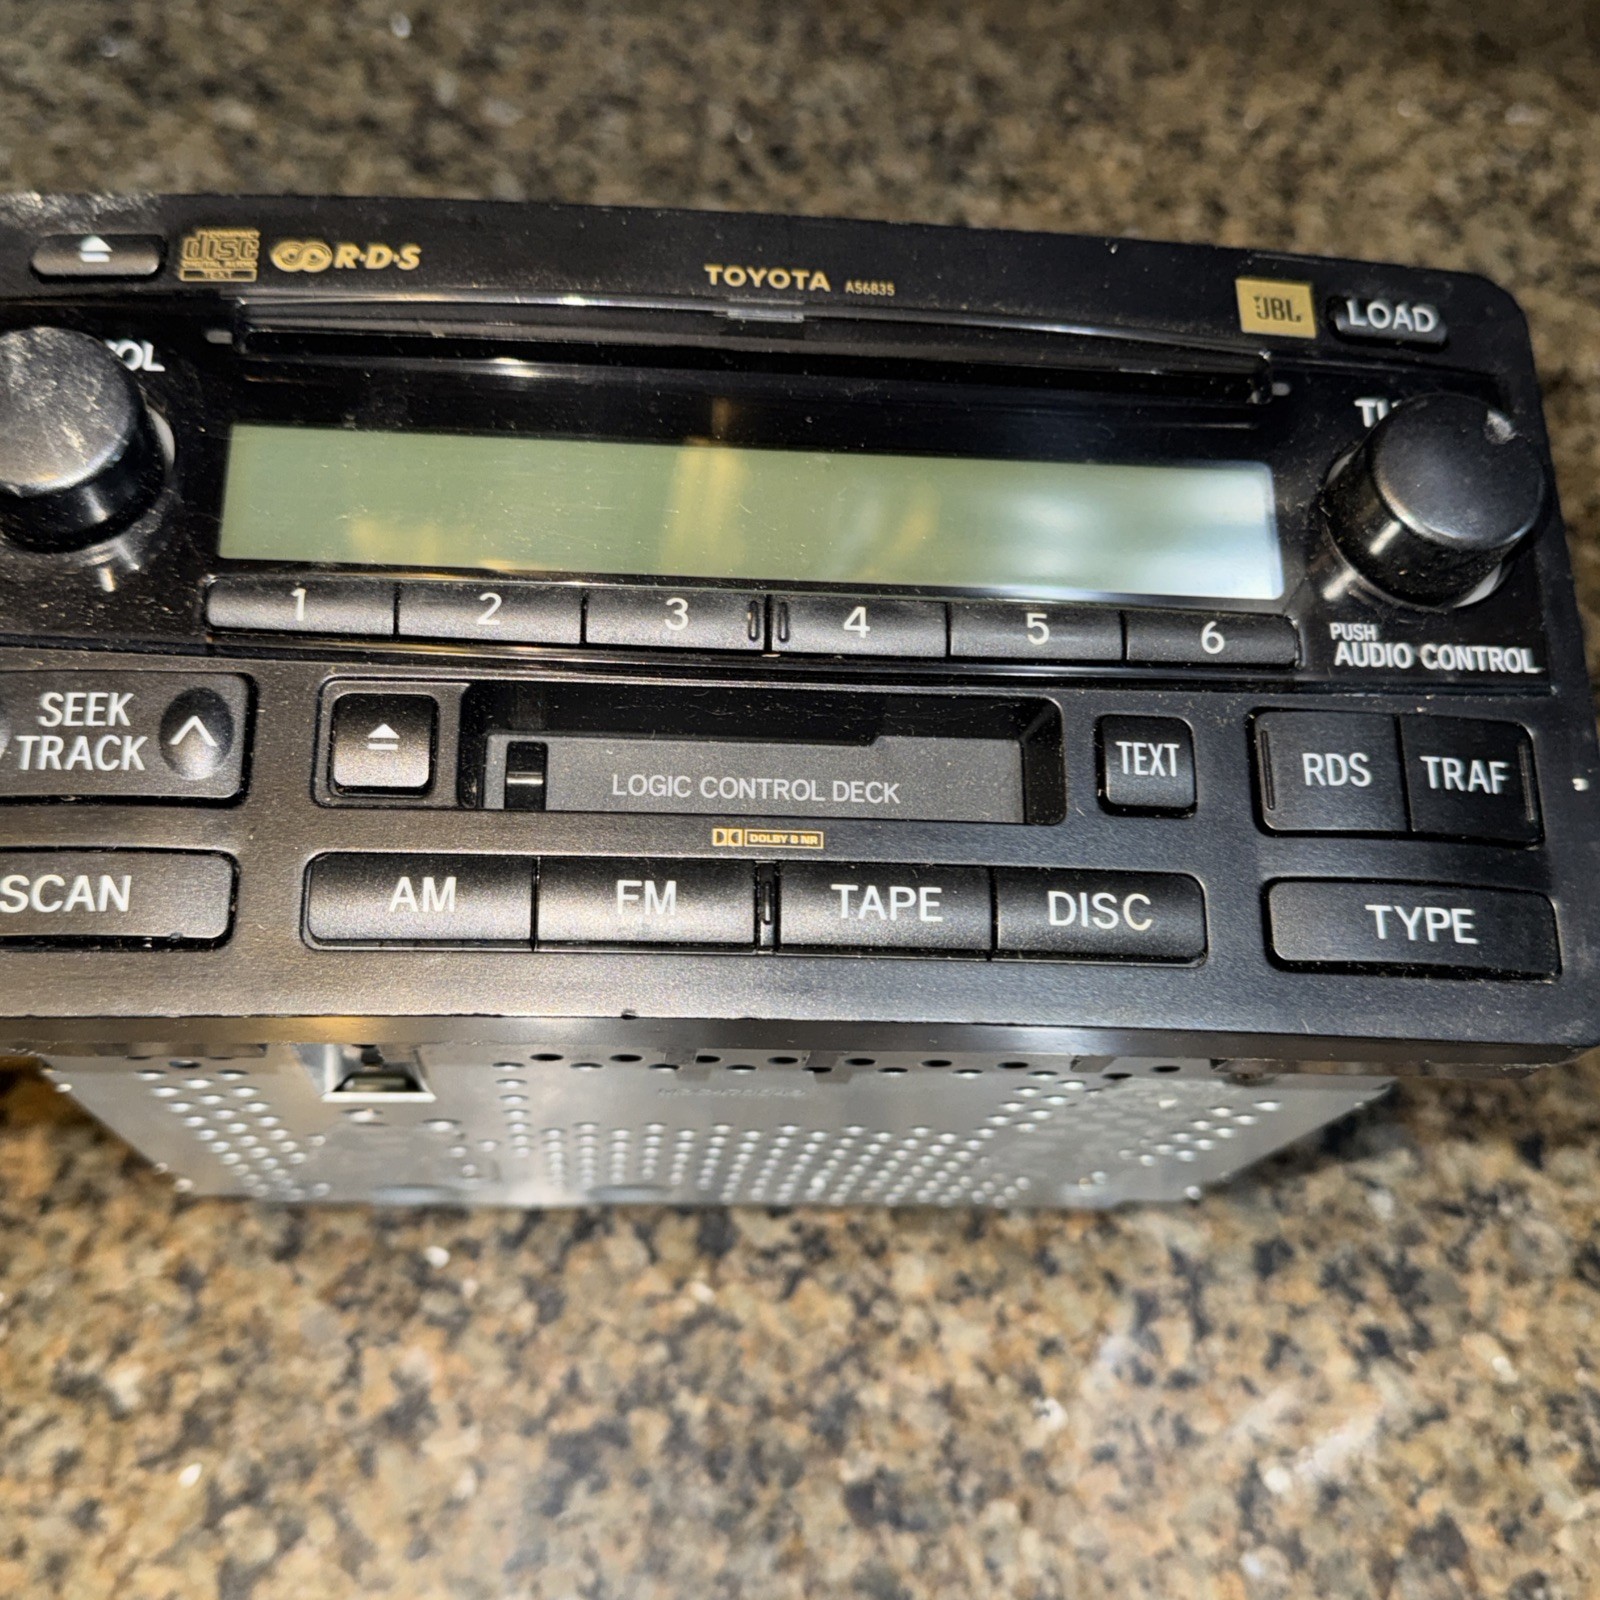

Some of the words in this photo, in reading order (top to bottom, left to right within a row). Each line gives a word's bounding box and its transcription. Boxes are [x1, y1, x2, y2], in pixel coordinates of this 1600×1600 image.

[704, 264, 831, 292] TOYOTA
[1253, 296, 1301, 322] JBL
[1346, 300, 1438, 333] LOAD
[104, 339, 166, 372] OL
[290, 588, 307, 621] 1
[478, 592, 502, 625] 2
[664, 597, 689, 630] 3
[843, 606, 870, 638] 4
[1026, 613, 1050, 645] 5
[1201, 621, 1225, 654] 6
[1330, 623, 1377, 640] PUSH
[1334, 643, 1413, 669] AUDIO
[1420, 644, 1541, 674] CONTROL
[37, 692, 134, 727] SEEK
[15, 736, 149, 771] TRACK
[1115, 741, 1180, 777] TEXT
[1302, 753, 1372, 787] RDS
[612, 774, 692, 798] LOGIC
[700, 777, 825, 801] CONTROL
[833, 781, 900, 803] DECK
[1420, 757, 1509, 794] TRAF
[749, 833, 789, 844] DOLBY
[0, 874, 132, 913] SCAN
[388, 876, 457, 912] AM
[615, 880, 678, 915] FM
[830, 884, 943, 922] TAPE
[1047, 891, 1154, 931] DISC
[1366, 905, 1480, 944] TYPE
